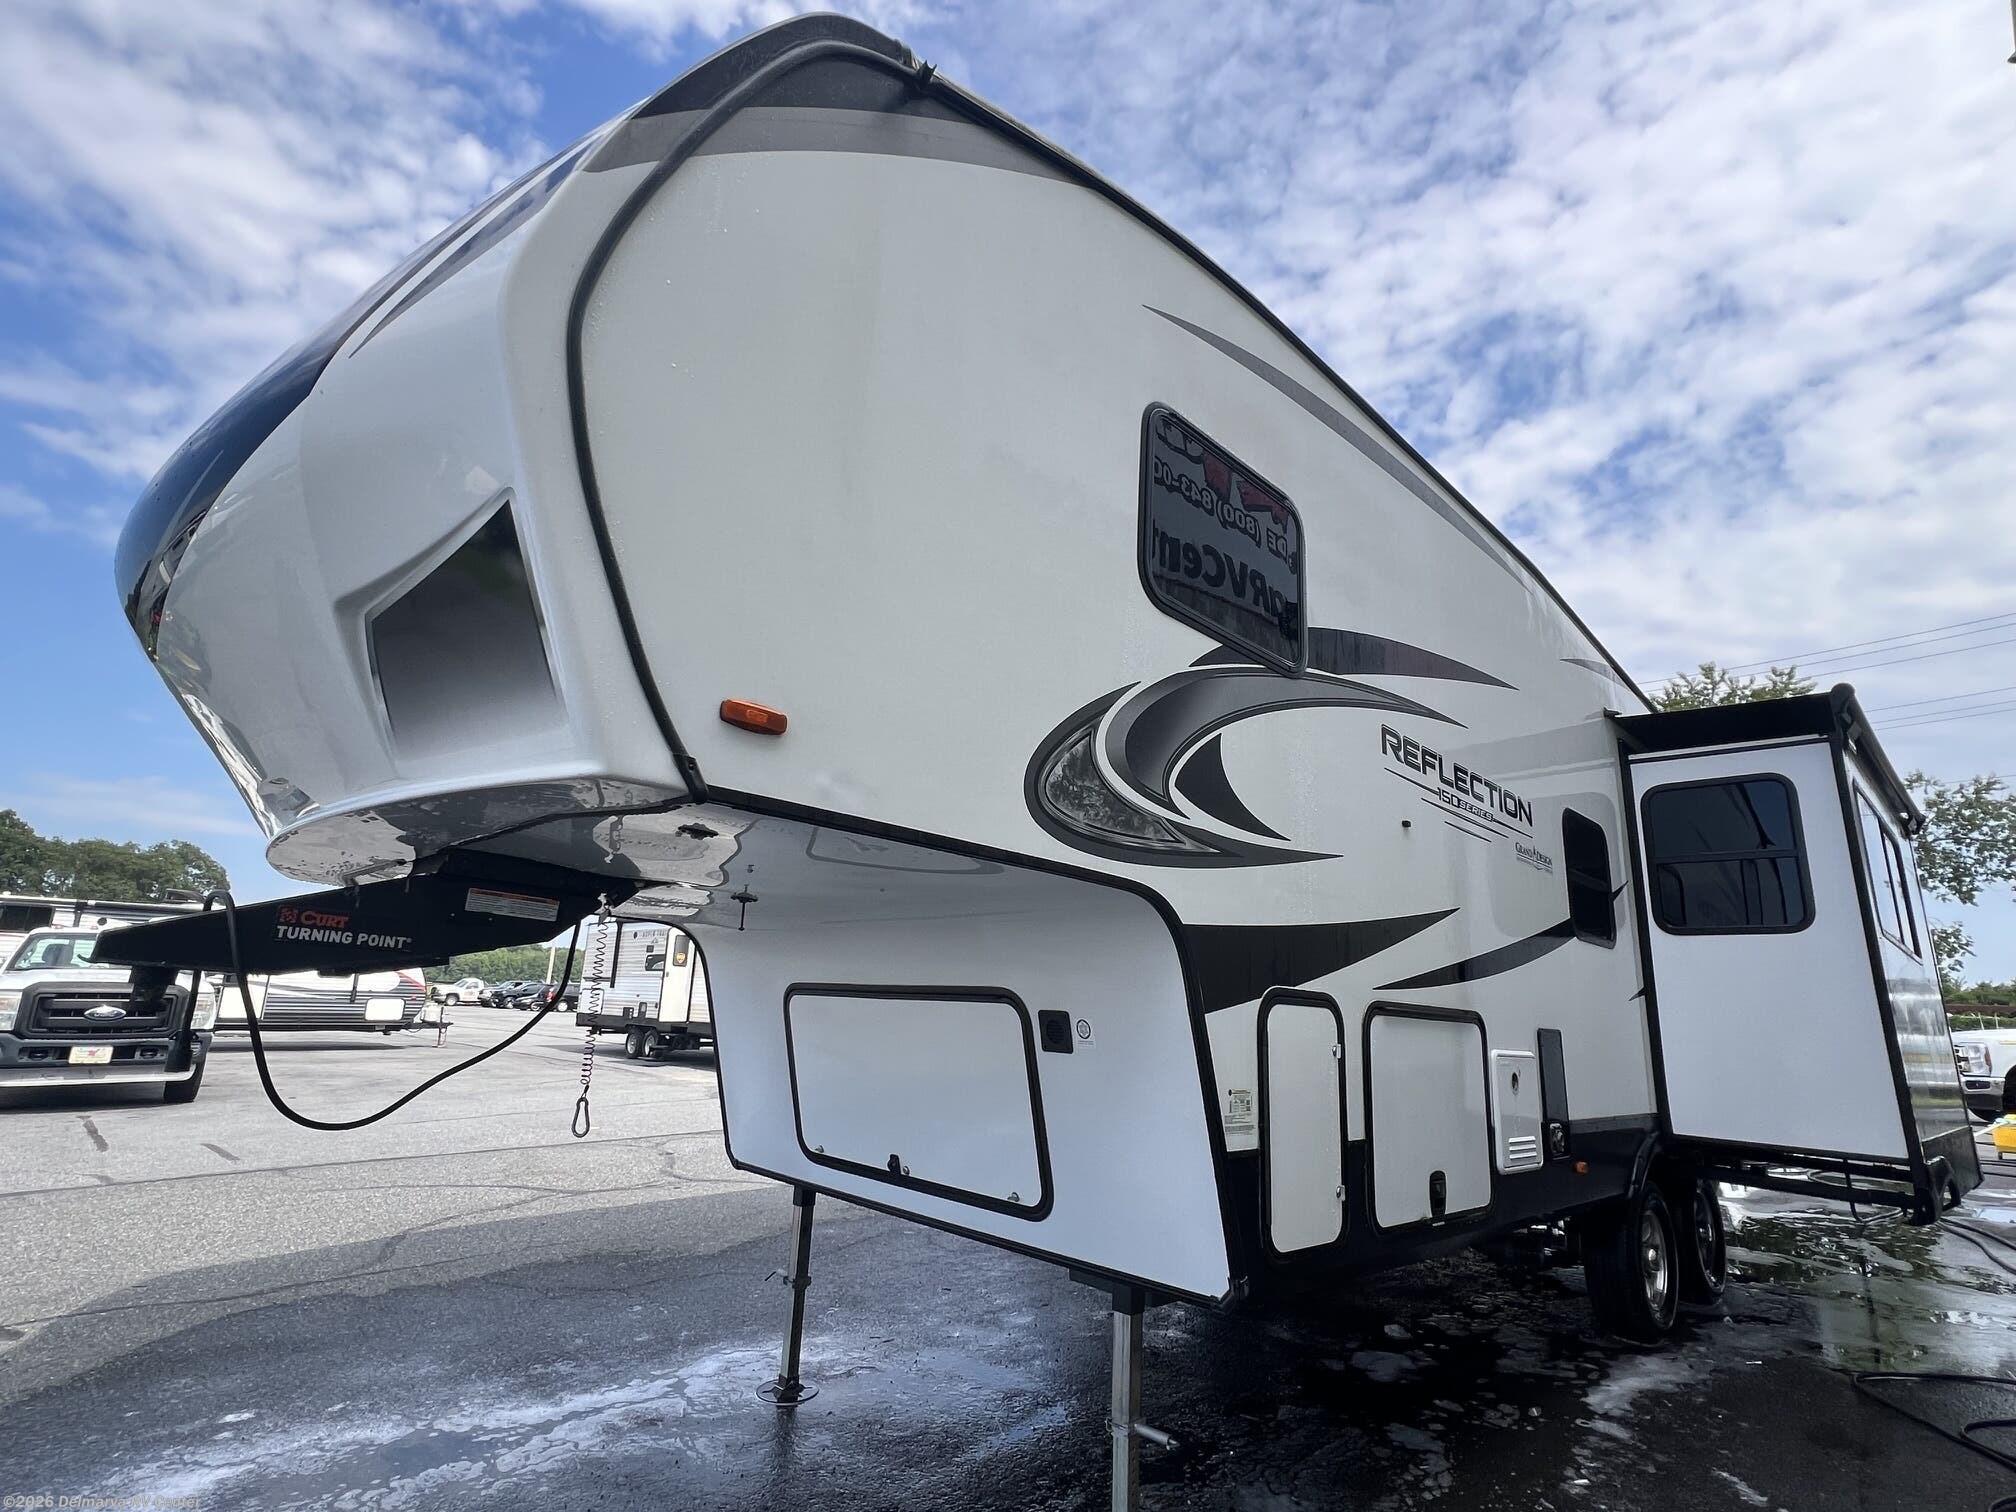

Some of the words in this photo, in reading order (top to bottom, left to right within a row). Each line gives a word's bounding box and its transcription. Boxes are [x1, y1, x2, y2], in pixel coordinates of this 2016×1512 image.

[1381, 723, 1533, 827] REFLECTION
[1437, 786, 1461, 808] 150
[1459, 799, 1495, 822] SERIES
[301, 910, 349, 928] CURT
[277, 925, 353, 944] TURNING
